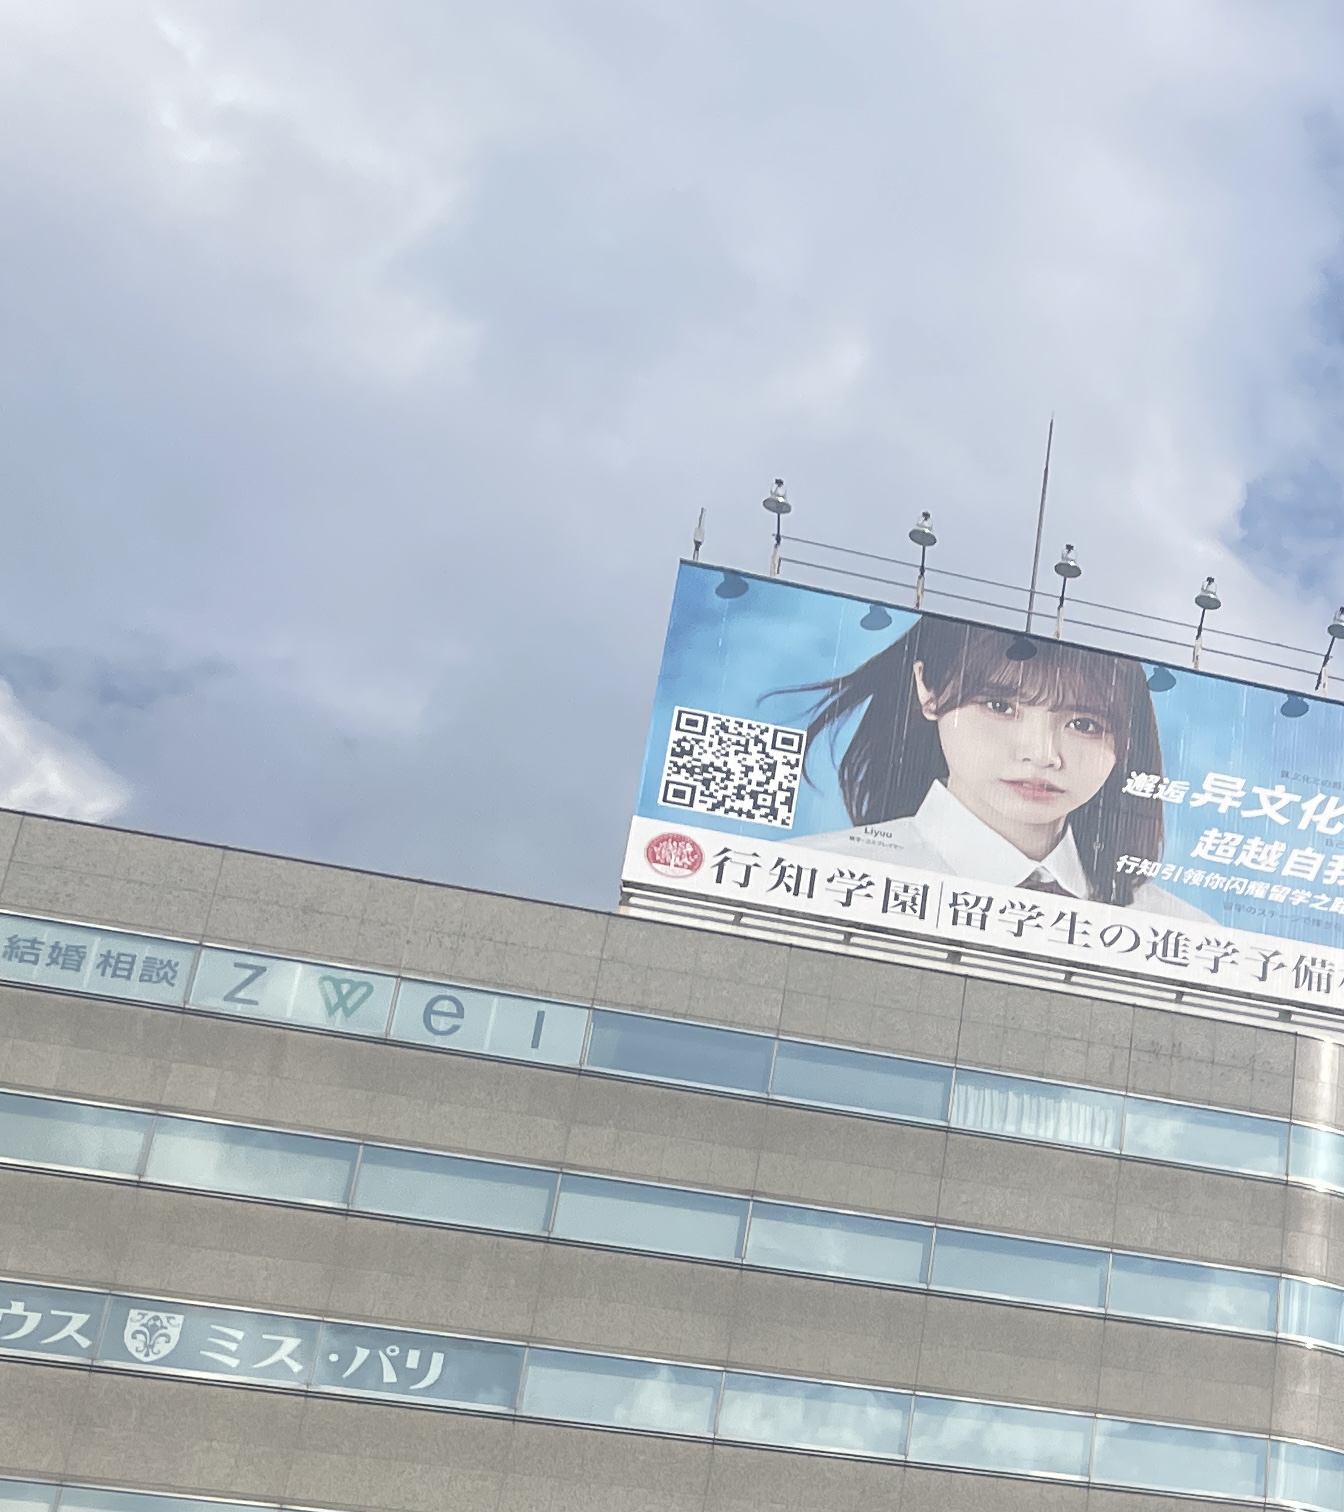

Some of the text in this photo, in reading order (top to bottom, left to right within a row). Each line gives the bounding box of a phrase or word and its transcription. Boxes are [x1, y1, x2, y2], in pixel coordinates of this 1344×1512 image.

[711, 847, 929, 920] 行知学園
[2, 934, 180, 986] 結婚相談
[200, 1324, 445, 1389] ミス・パリ
